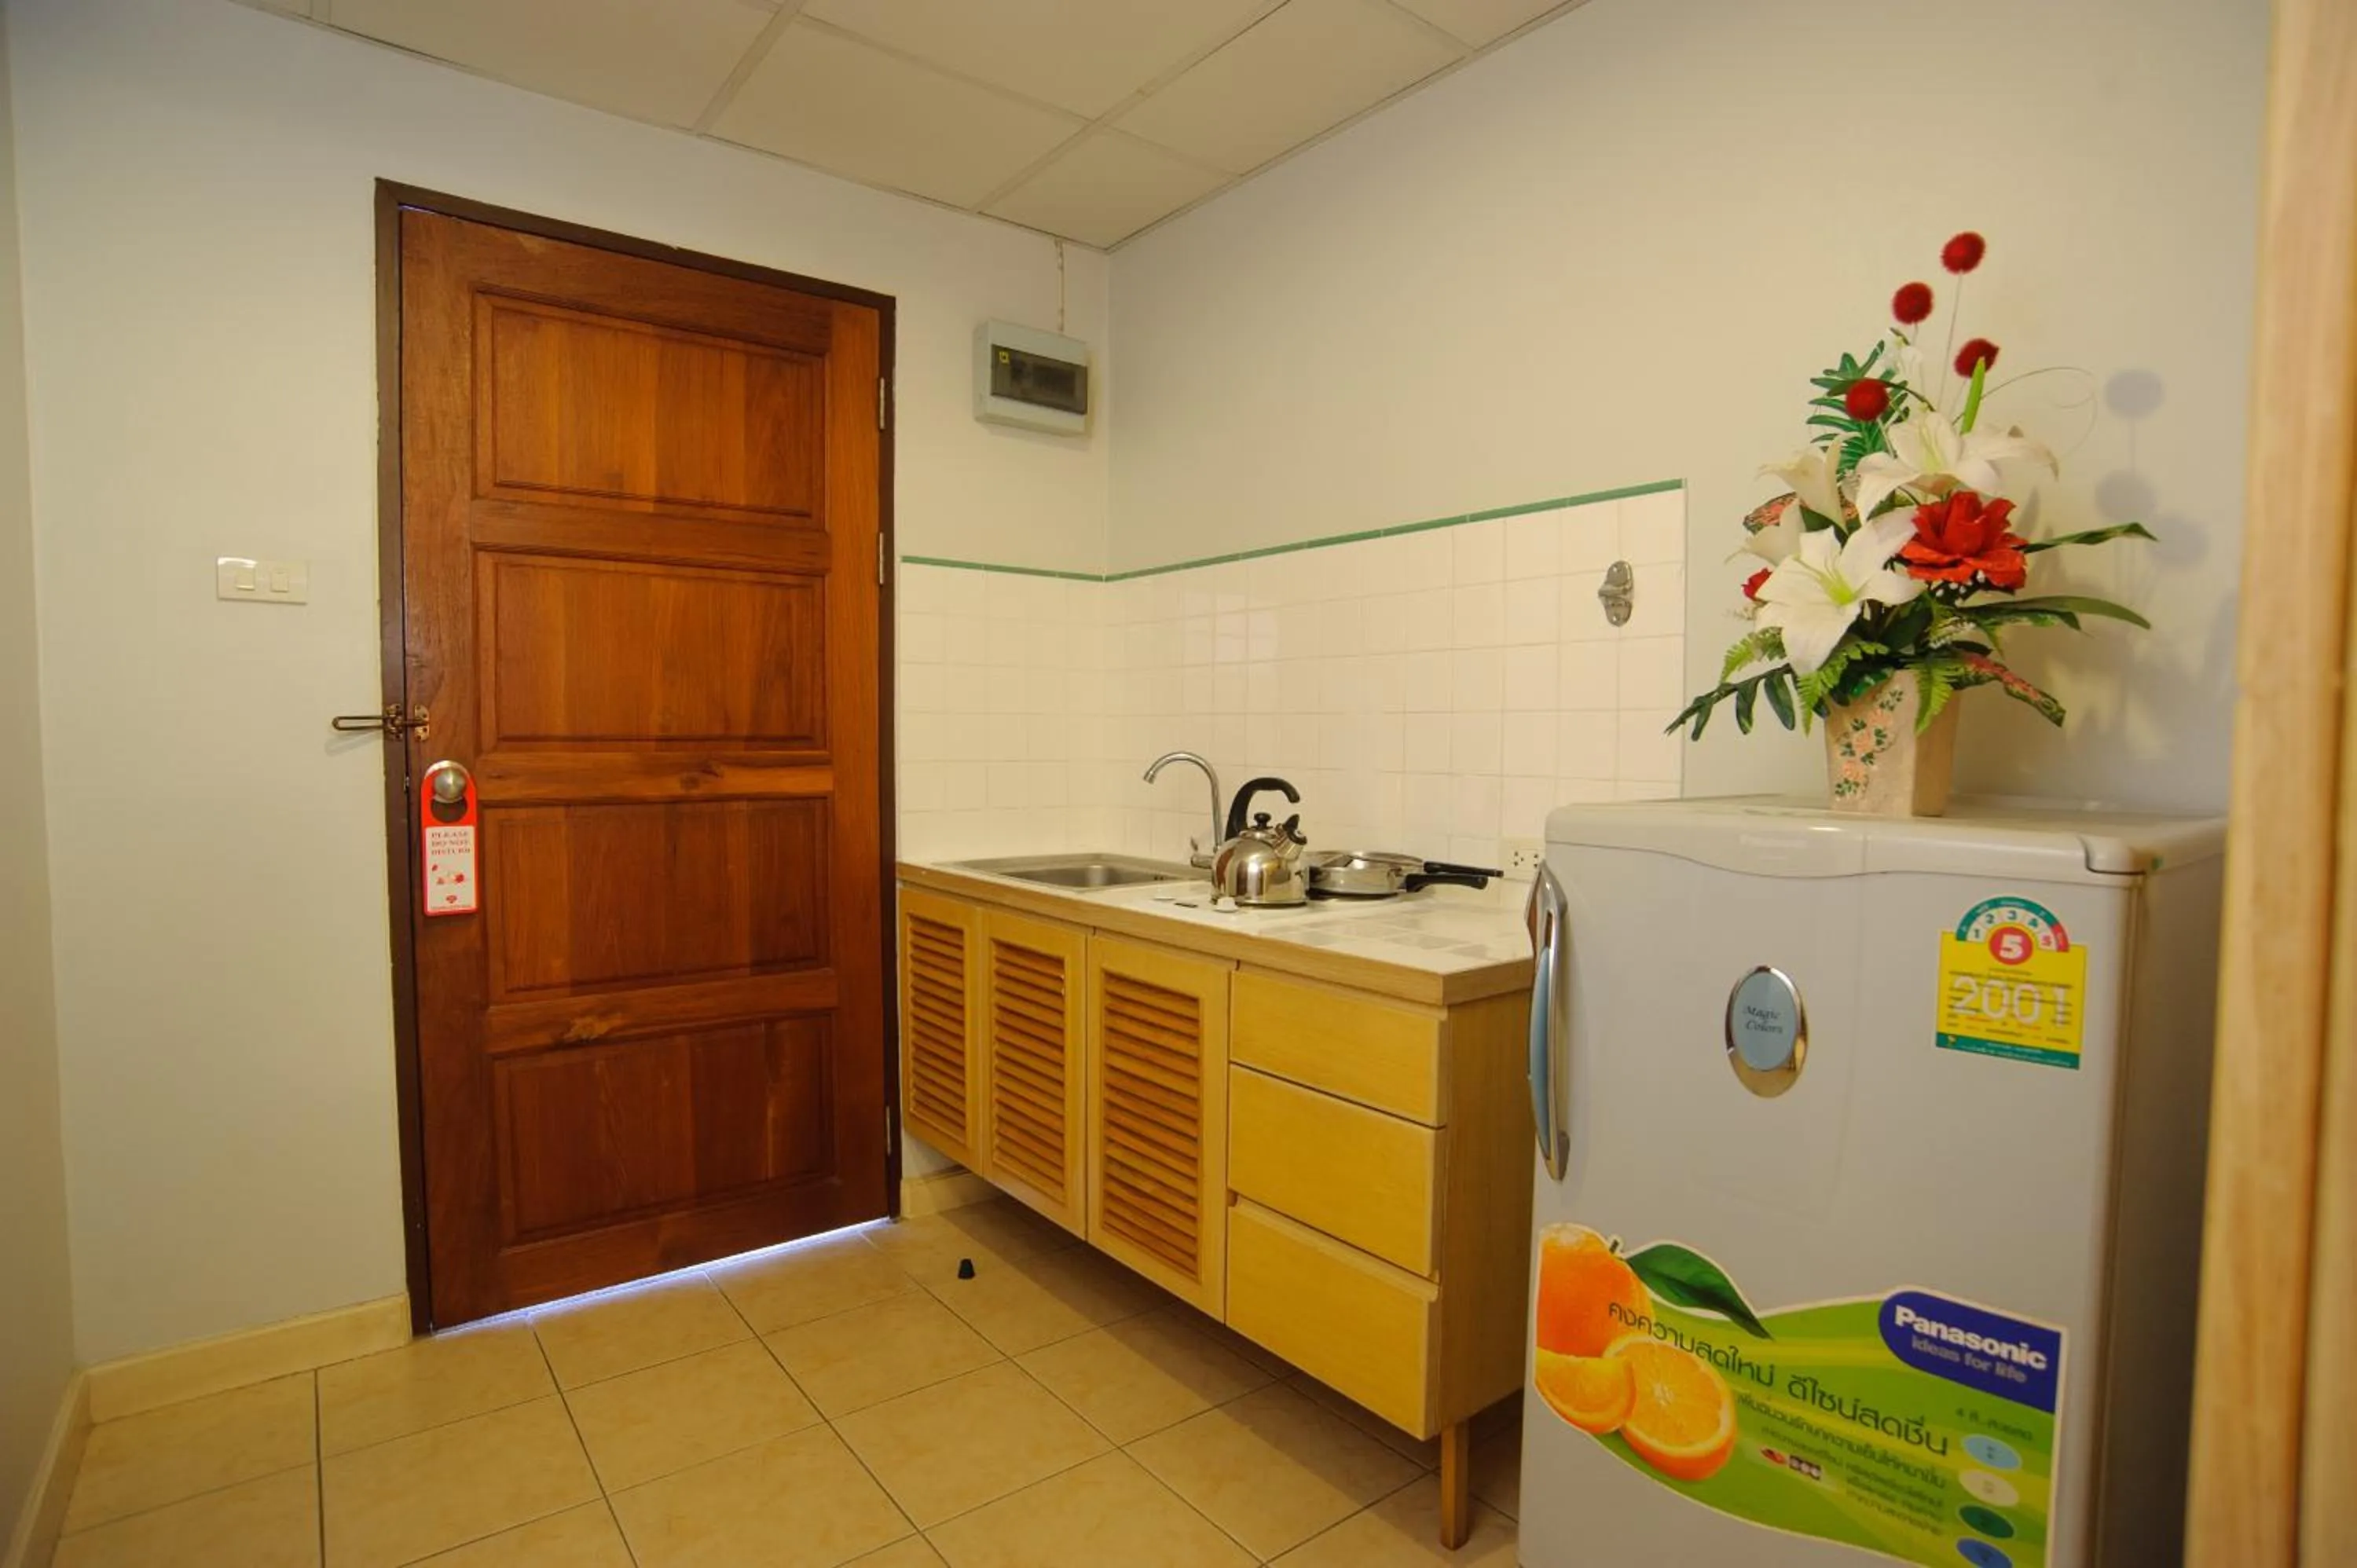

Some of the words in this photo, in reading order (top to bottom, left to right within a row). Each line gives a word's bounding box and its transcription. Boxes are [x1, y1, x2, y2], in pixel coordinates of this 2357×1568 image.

[1985, 913, 1995, 924] 2
[2007, 910, 2018, 921] 3
[1999, 933, 2024, 959] 5
[1608, 1302, 1775, 1387] คงความสดใหม่
[1895, 1305, 2047, 1371] Panasonic
[1965, 1353, 1992, 1372] for
[1996, 1361, 2028, 1383] life
